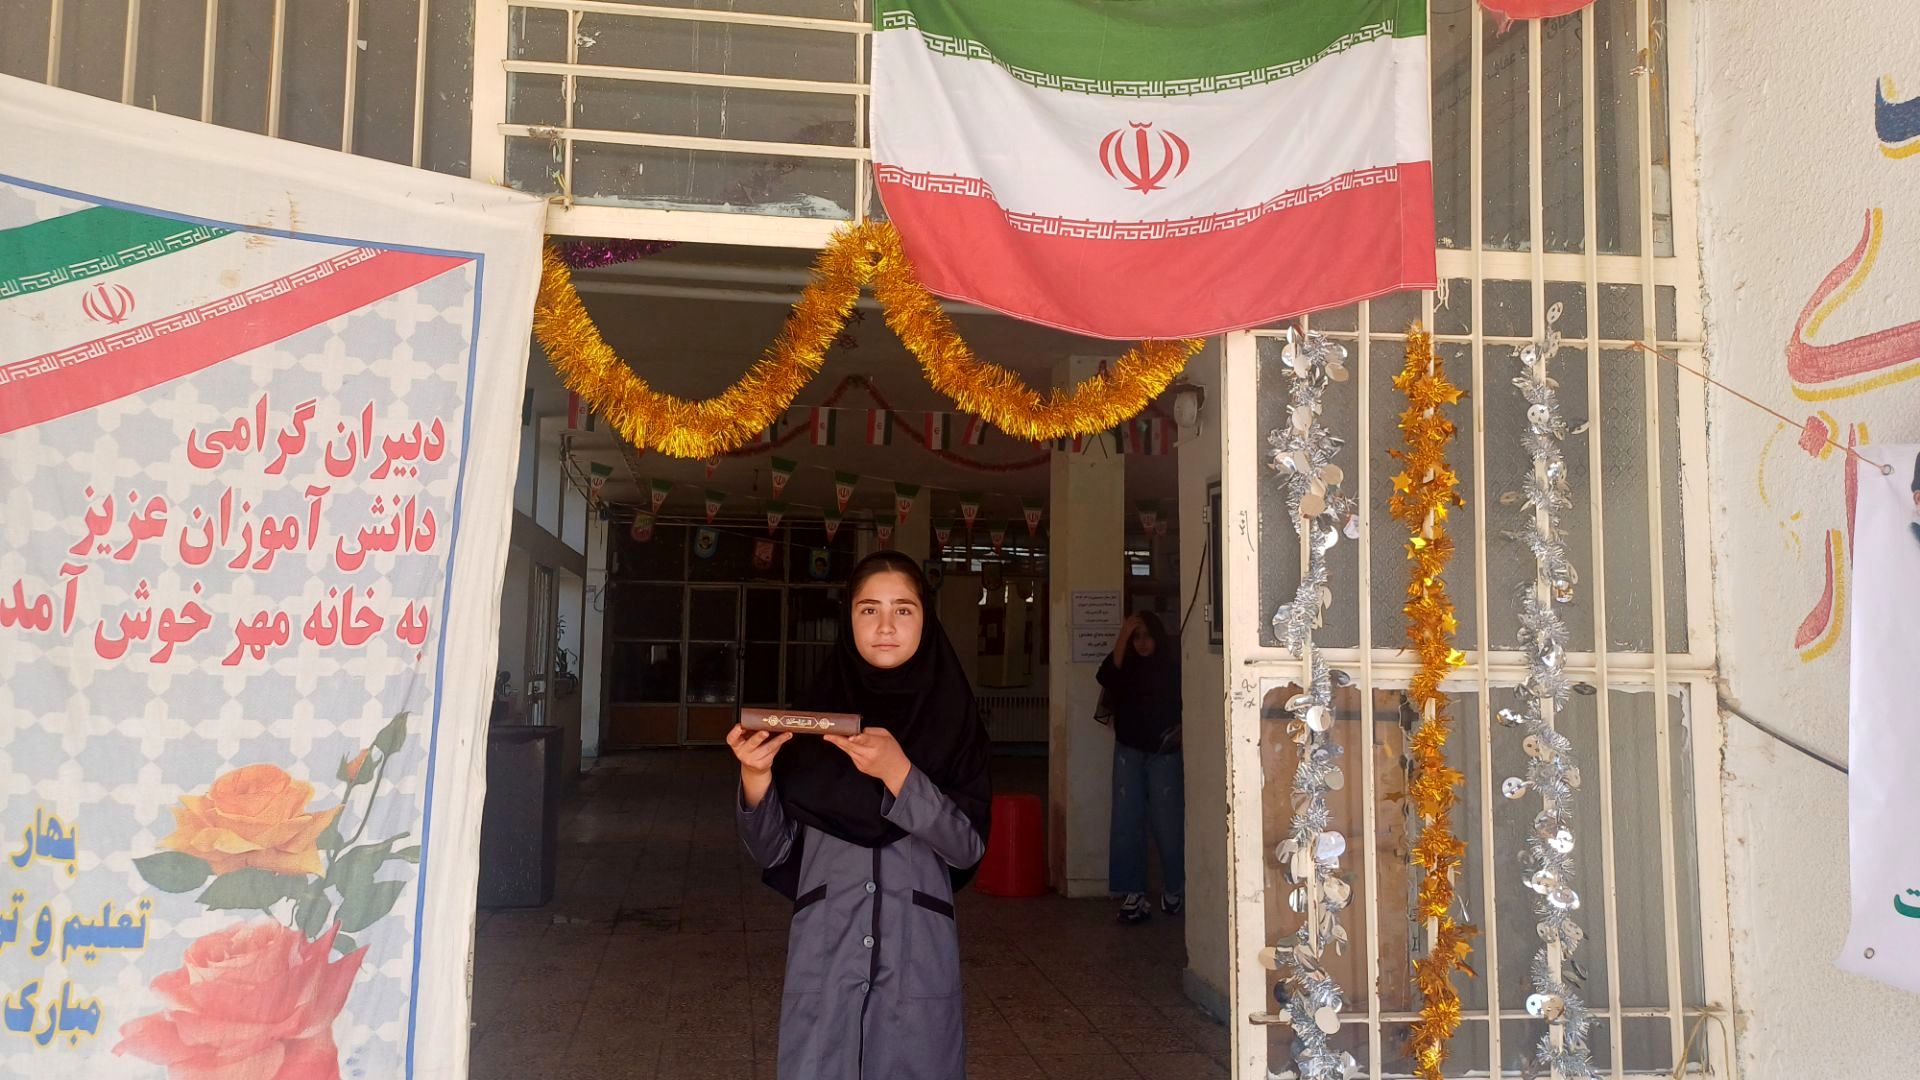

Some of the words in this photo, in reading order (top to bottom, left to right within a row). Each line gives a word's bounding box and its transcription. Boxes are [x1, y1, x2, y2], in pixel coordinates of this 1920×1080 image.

[187, 393, 316, 475] گرامی
[325, 401, 446, 480] دبیران
[69, 486, 168, 561] عزیز
[179, 485, 331, 571] آموزان
[335, 494, 437, 572] دانش
[94, 579, 213, 664] خوش
[221, 610, 291, 667] مهر
[303, 585, 385, 647] خانه
[396, 600, 430, 662] به
[11, 808, 76, 875] بهار
[31, 905, 52, 956] و
[62, 900, 152, 962] تعلیم
[4, 979, 101, 1046] مبارک
